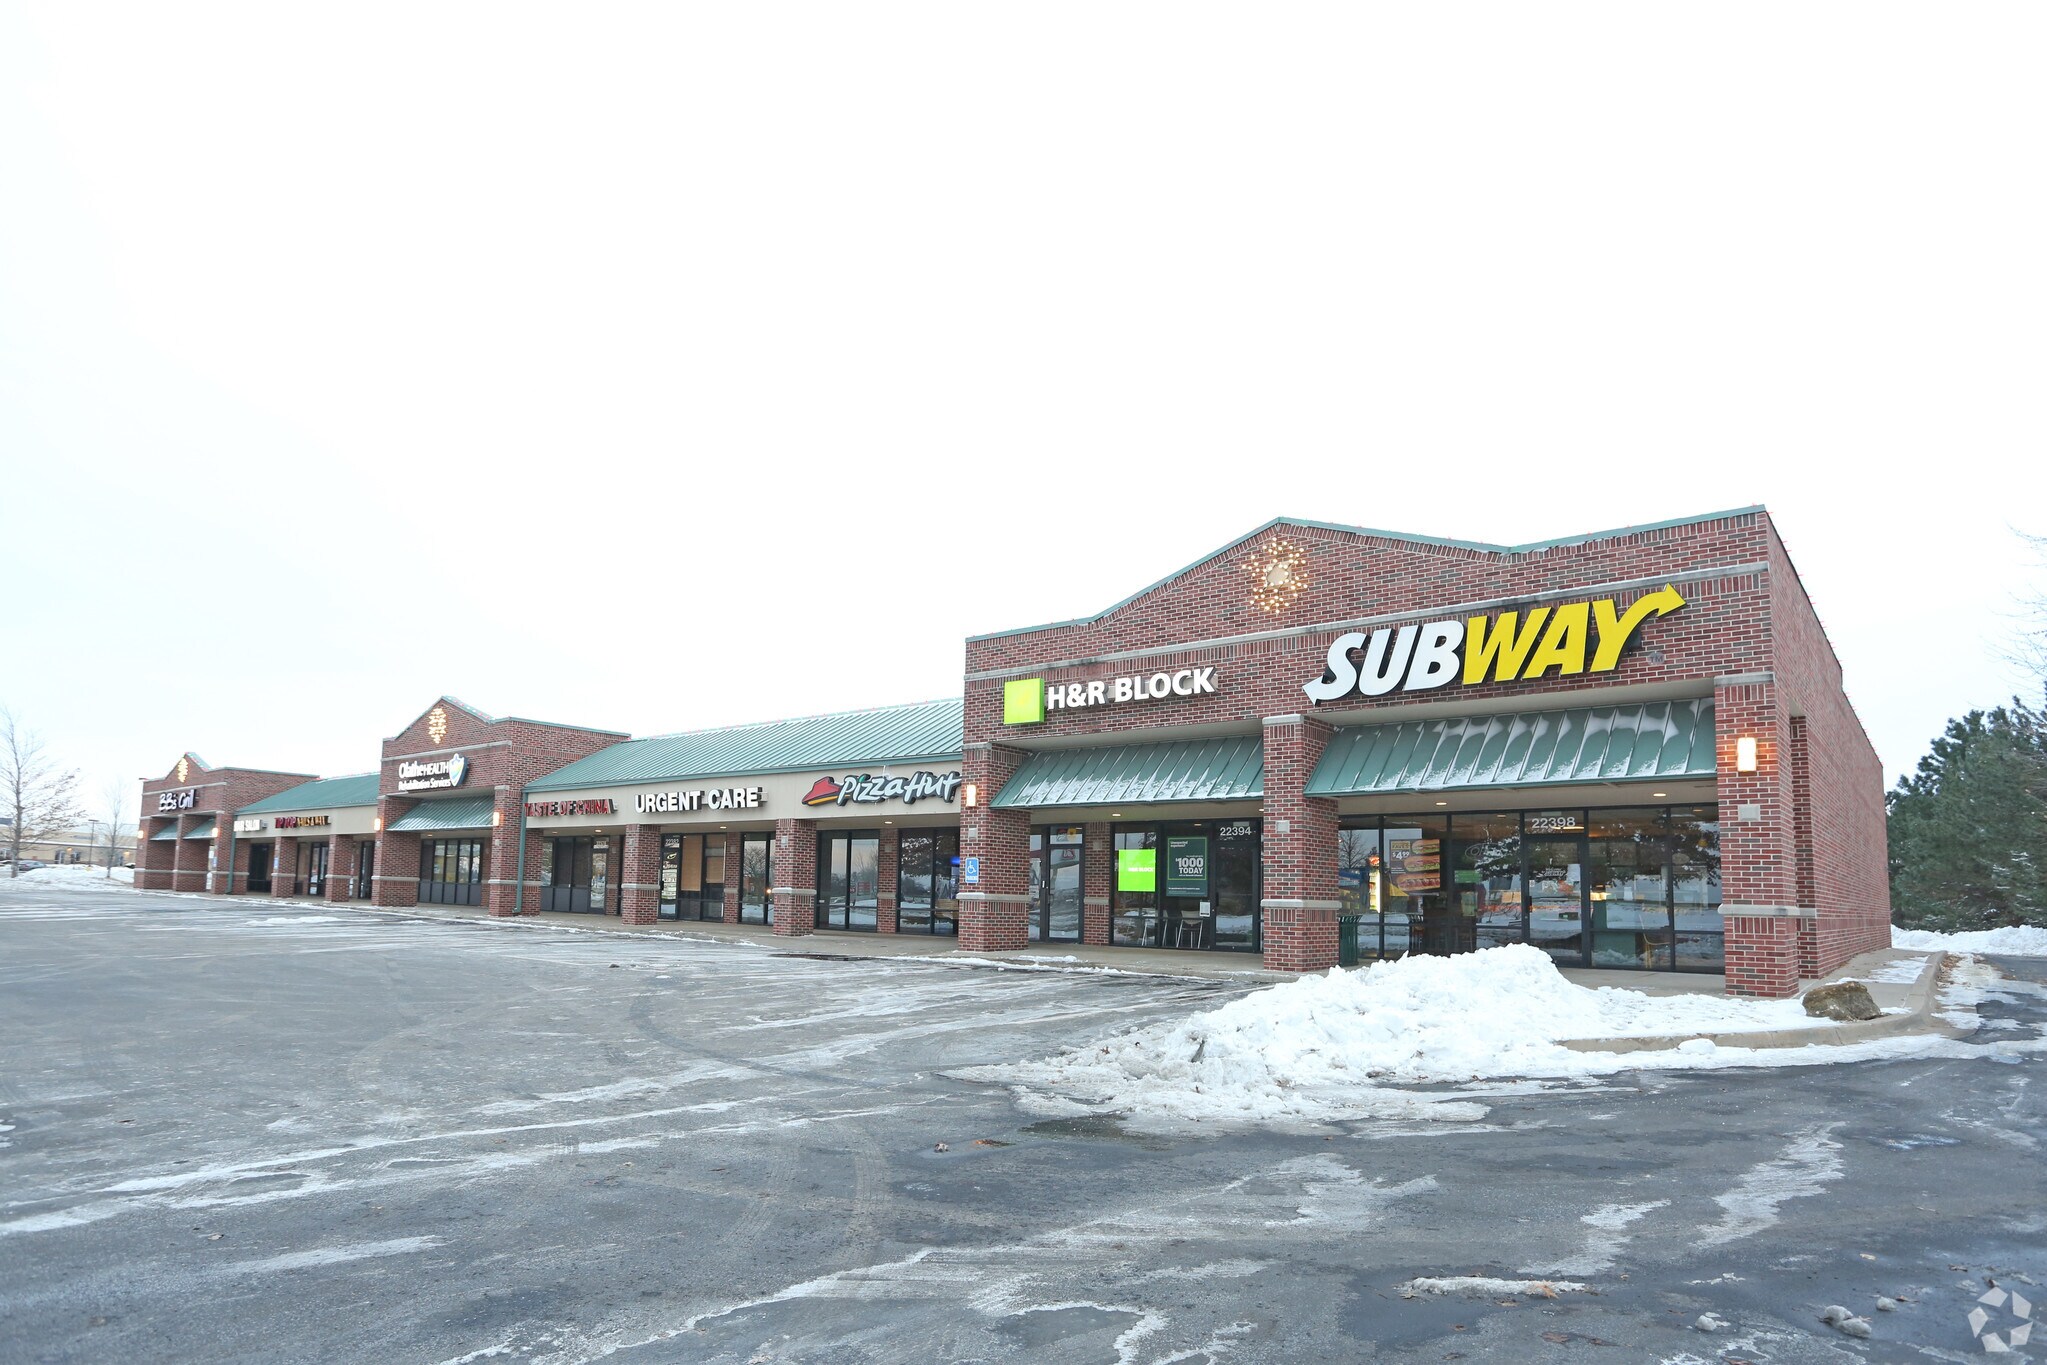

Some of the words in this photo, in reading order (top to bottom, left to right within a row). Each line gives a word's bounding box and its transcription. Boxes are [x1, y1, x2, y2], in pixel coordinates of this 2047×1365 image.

[1302, 584, 1687, 705] SUBWAY
[1048, 681, 1106, 710] H&R
[1115, 667, 1216, 702] BLOCK
[431, 778, 451, 788] Services
[837, 774, 904, 806] Pizza
[904, 771, 962, 804] Hut
[525, 801, 556, 817] TASTE
[559, 801, 573, 816] OF
[576, 799, 612, 815] CHINA
[634, 790, 701, 813] URGENT
[707, 787, 759, 809] CARE
[1220, 827, 1252, 836] 22394
[1531, 817, 1576, 829] 22398
